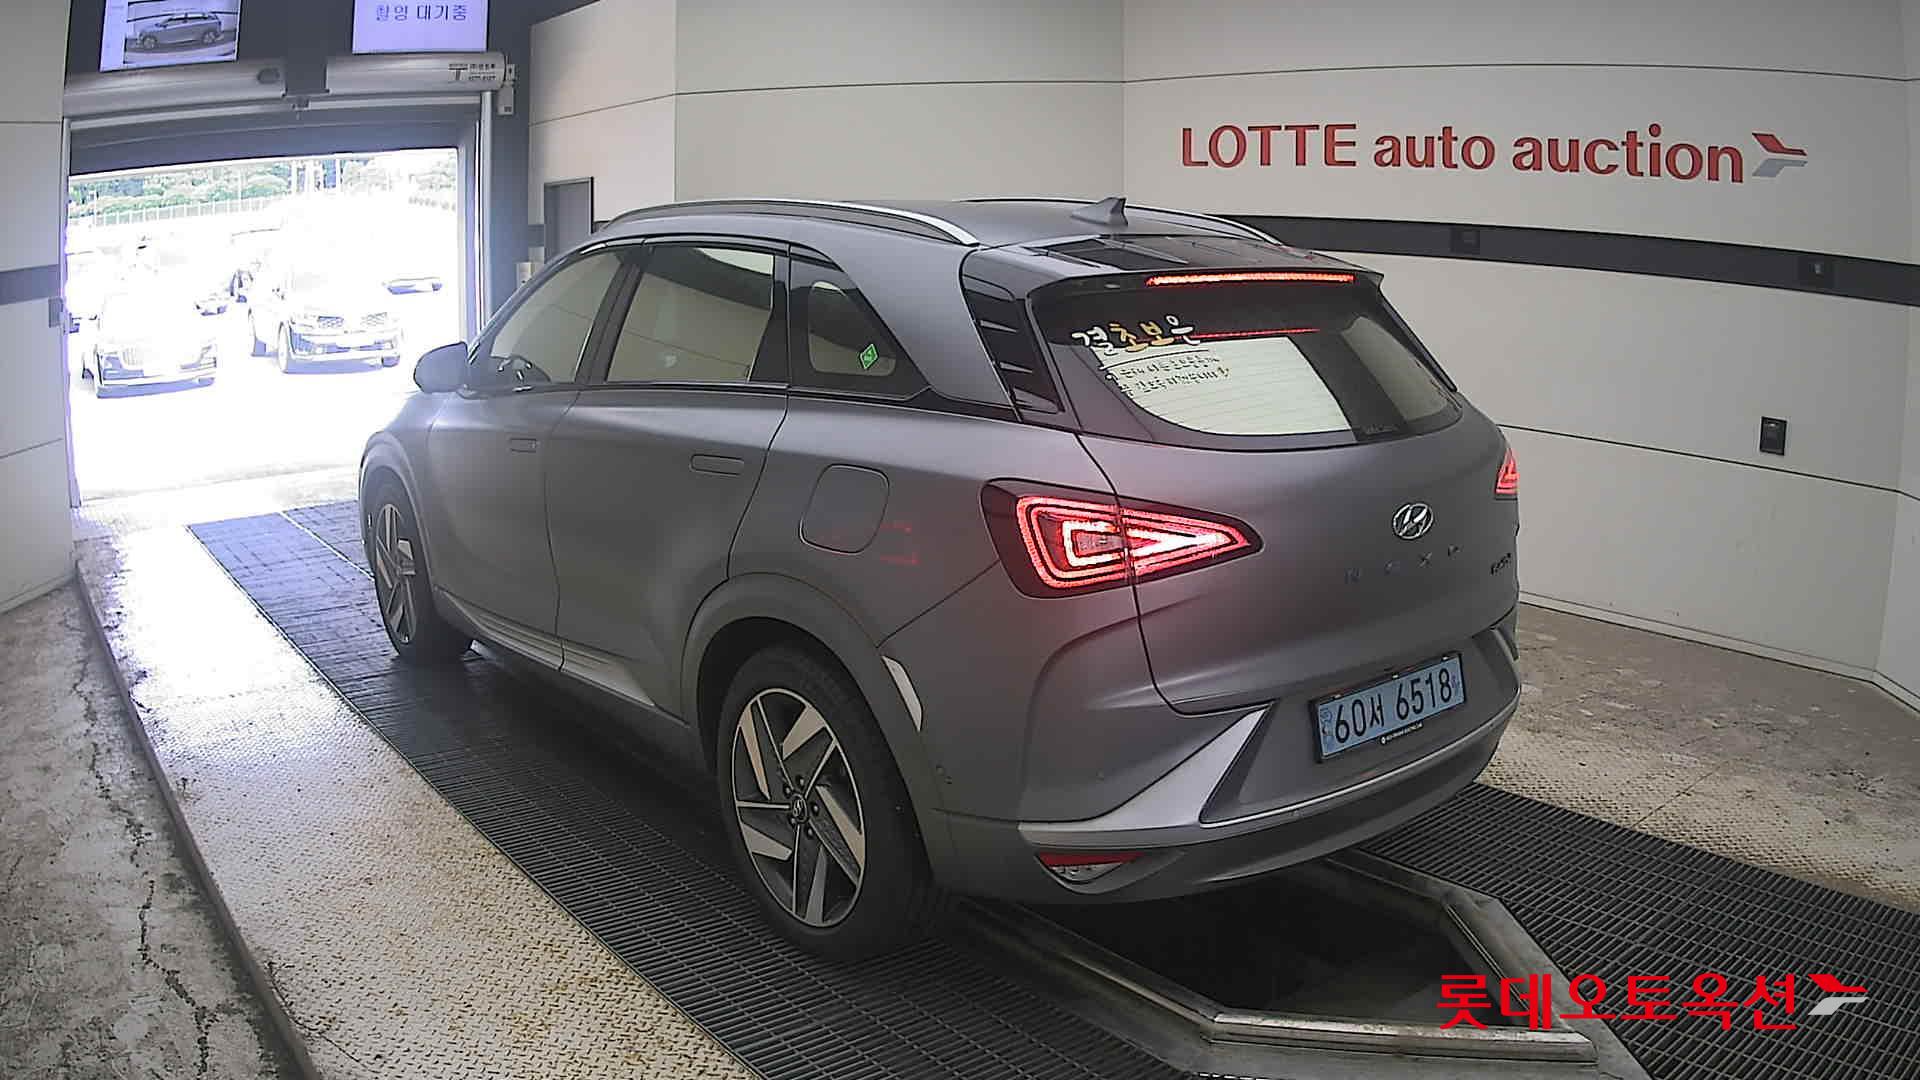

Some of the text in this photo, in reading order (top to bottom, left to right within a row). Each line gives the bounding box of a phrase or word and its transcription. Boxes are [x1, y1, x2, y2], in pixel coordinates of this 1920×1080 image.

[417, 5, 467, 21] 대기중
[1182, 122, 1744, 183] LOTTE auto auction
[1335, 693, 1385, 743] 60서
[1396, 668, 1452, 720] 6518
